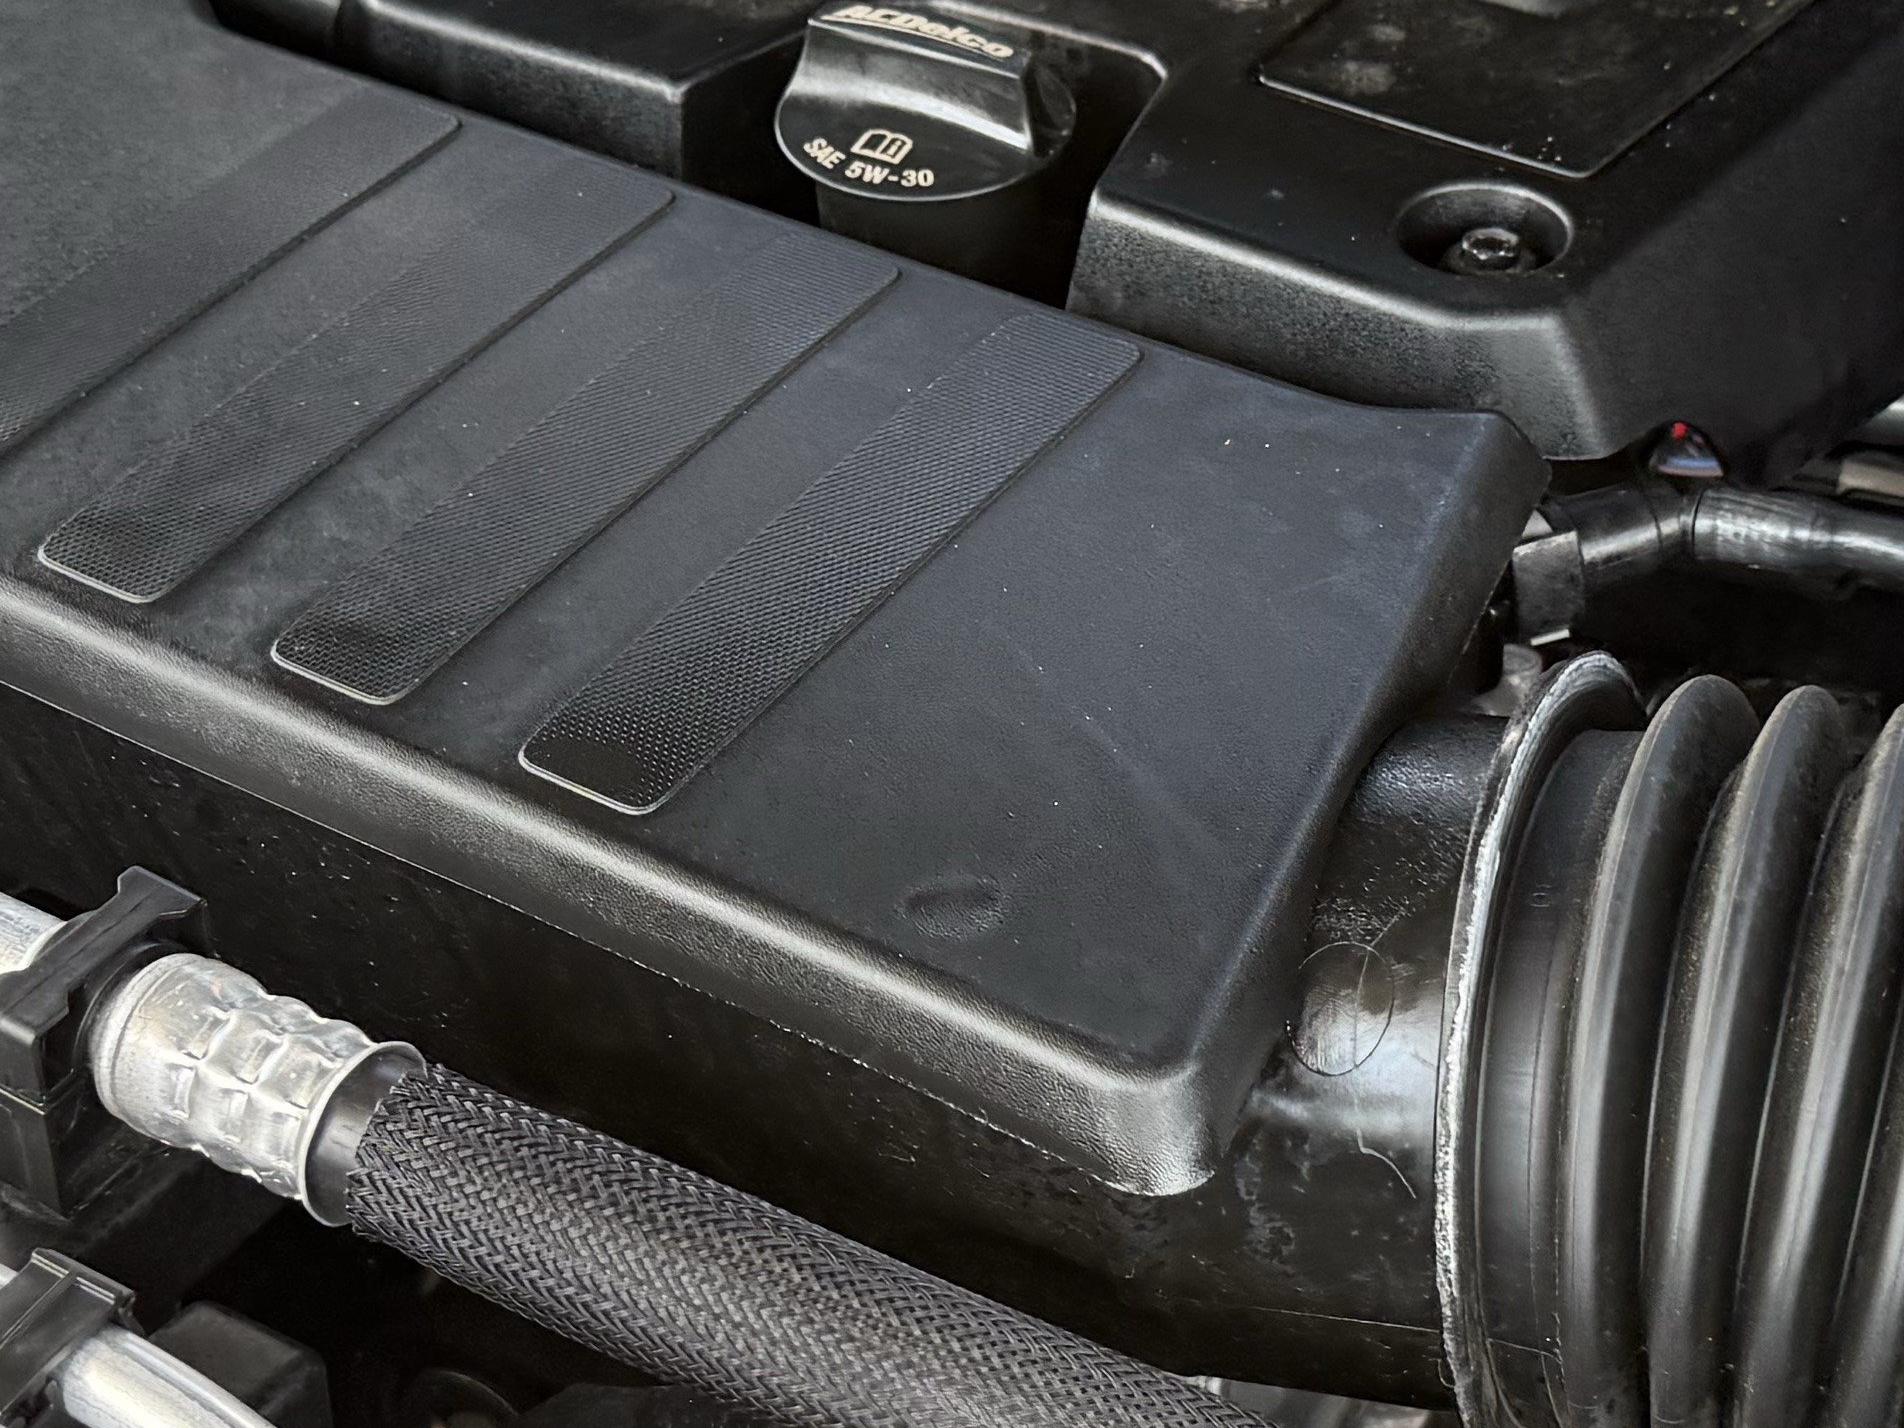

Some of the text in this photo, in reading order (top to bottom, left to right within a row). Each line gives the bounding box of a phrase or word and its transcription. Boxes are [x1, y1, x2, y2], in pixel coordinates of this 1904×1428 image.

[822, 4, 1014, 61] ACDelco
[803, 137, 935, 188] SAE 5W-30
